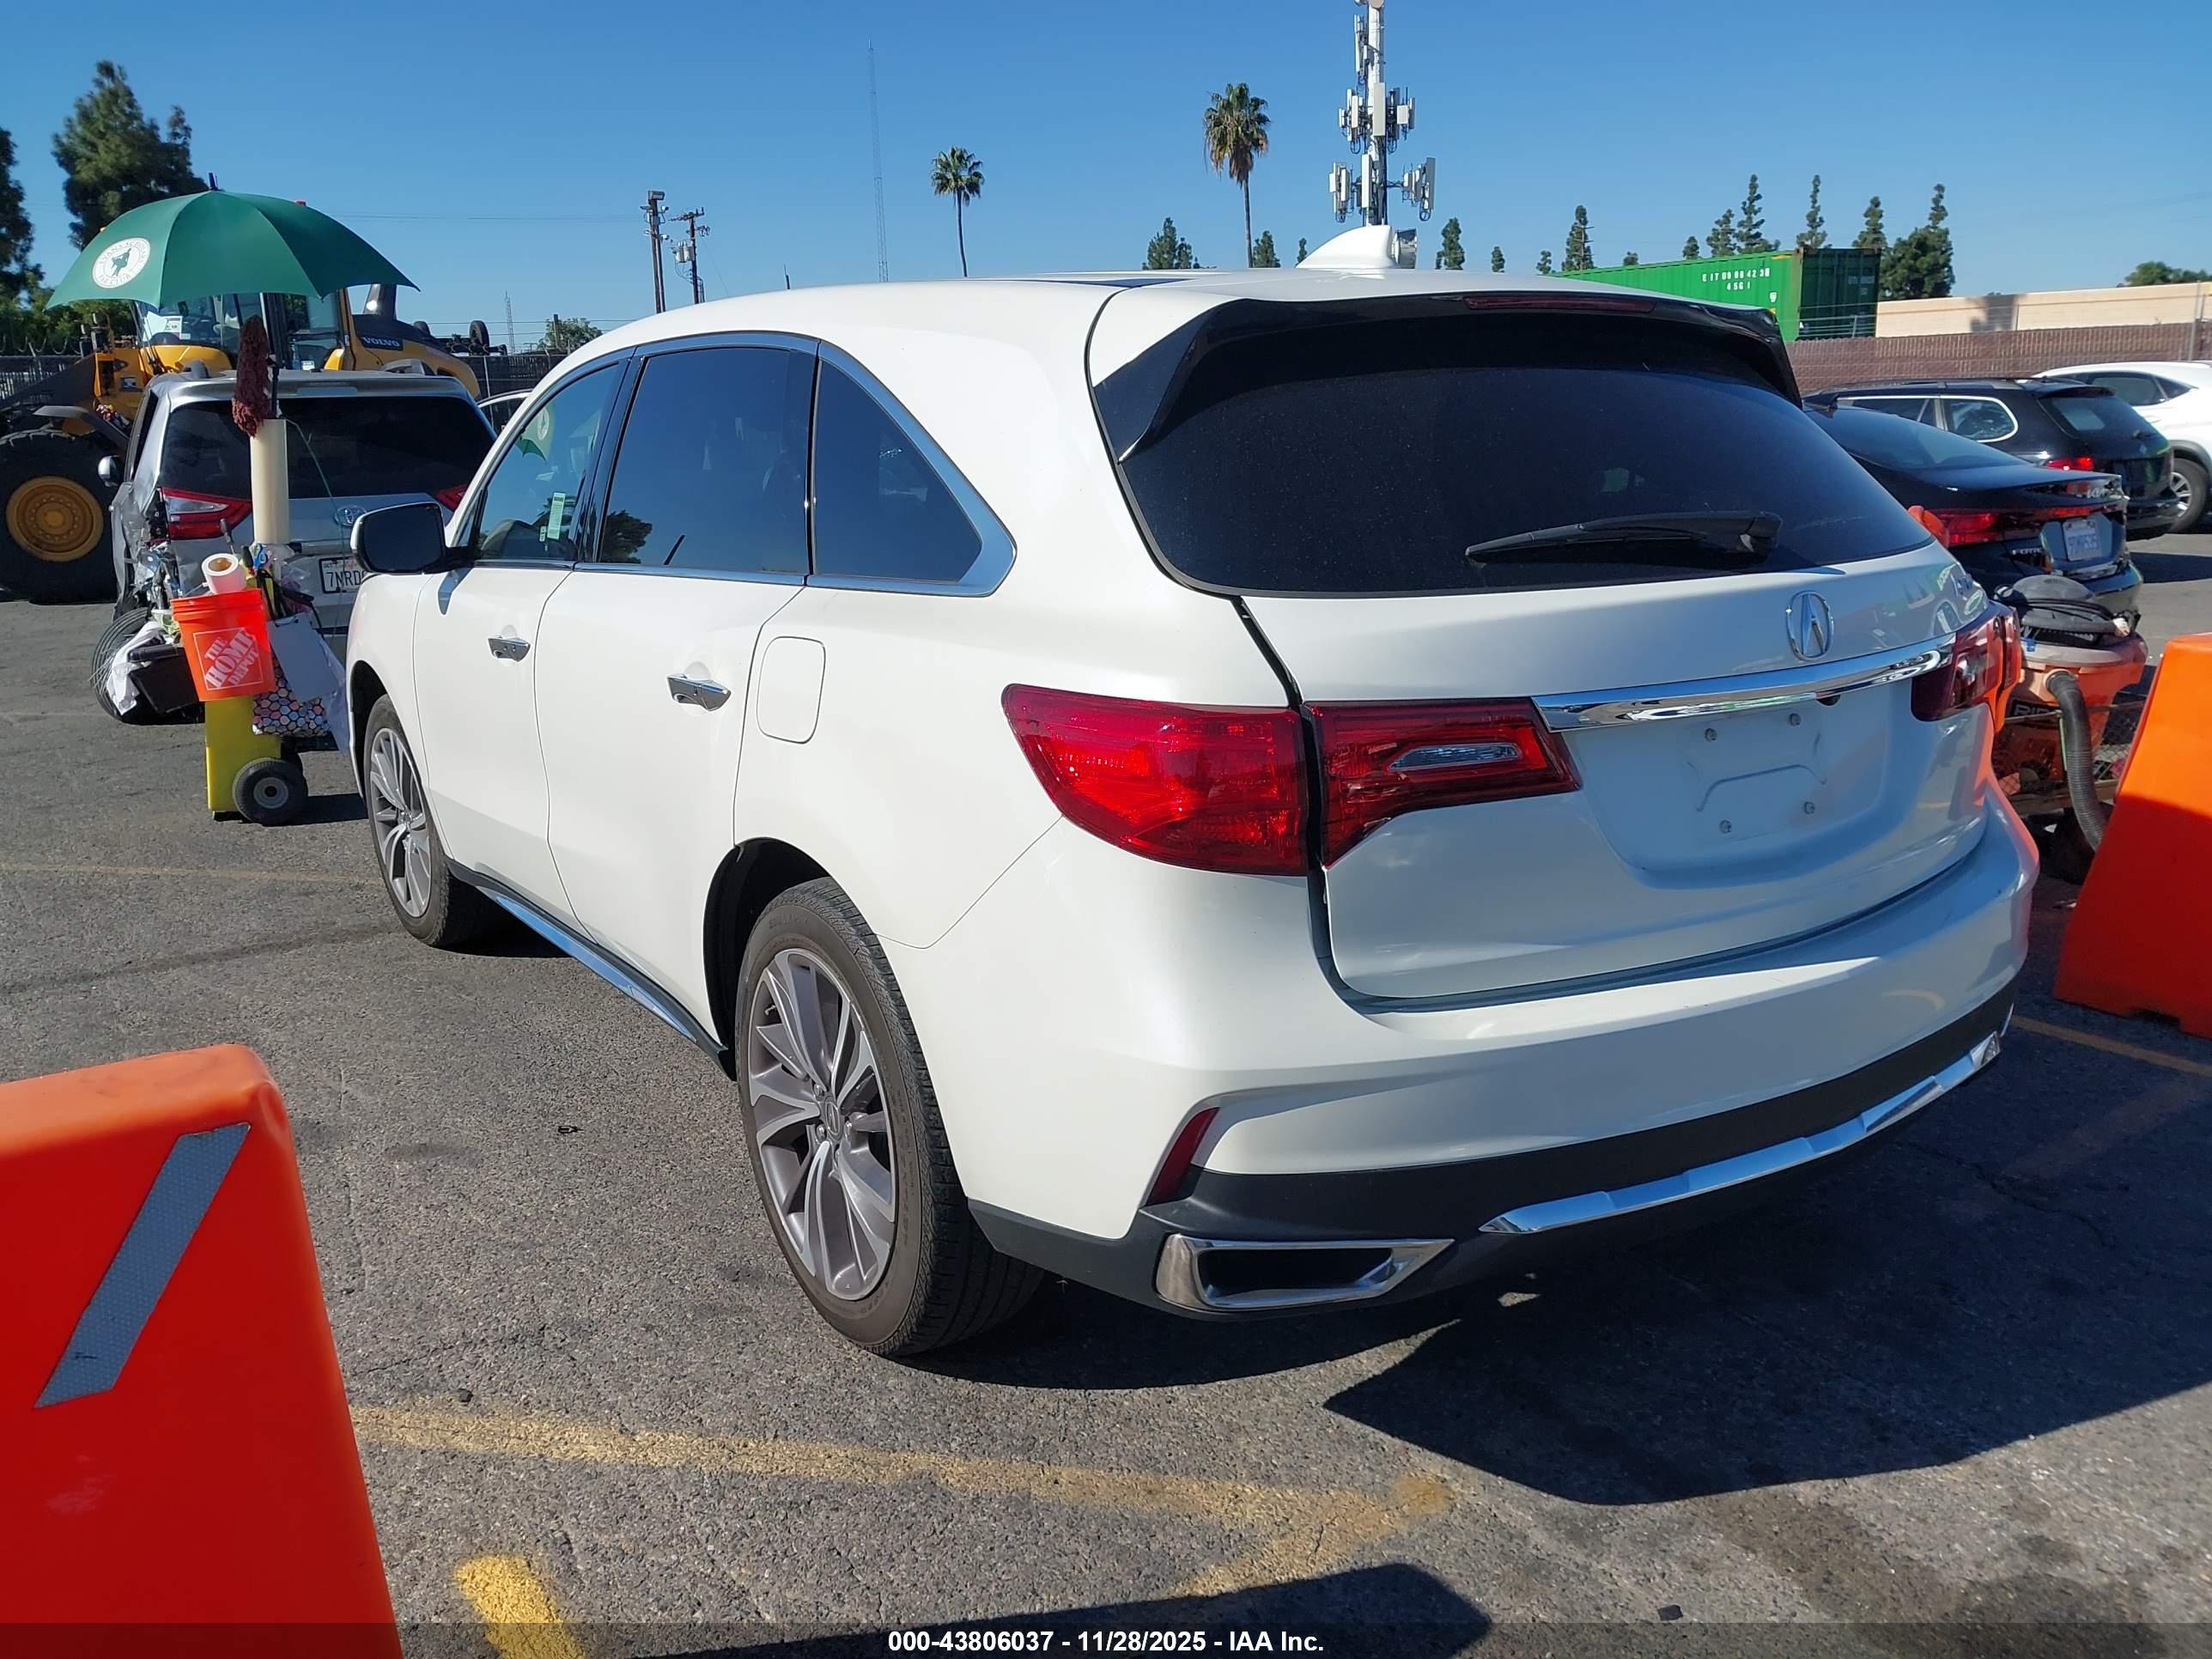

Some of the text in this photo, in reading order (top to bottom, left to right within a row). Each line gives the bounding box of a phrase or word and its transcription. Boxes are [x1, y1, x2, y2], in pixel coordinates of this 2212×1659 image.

[362, 337, 400, 347] VOLVO
[204, 637, 228, 661] THE
[205, 631, 254, 688] HOME
[227, 647, 258, 685] DEPOT
